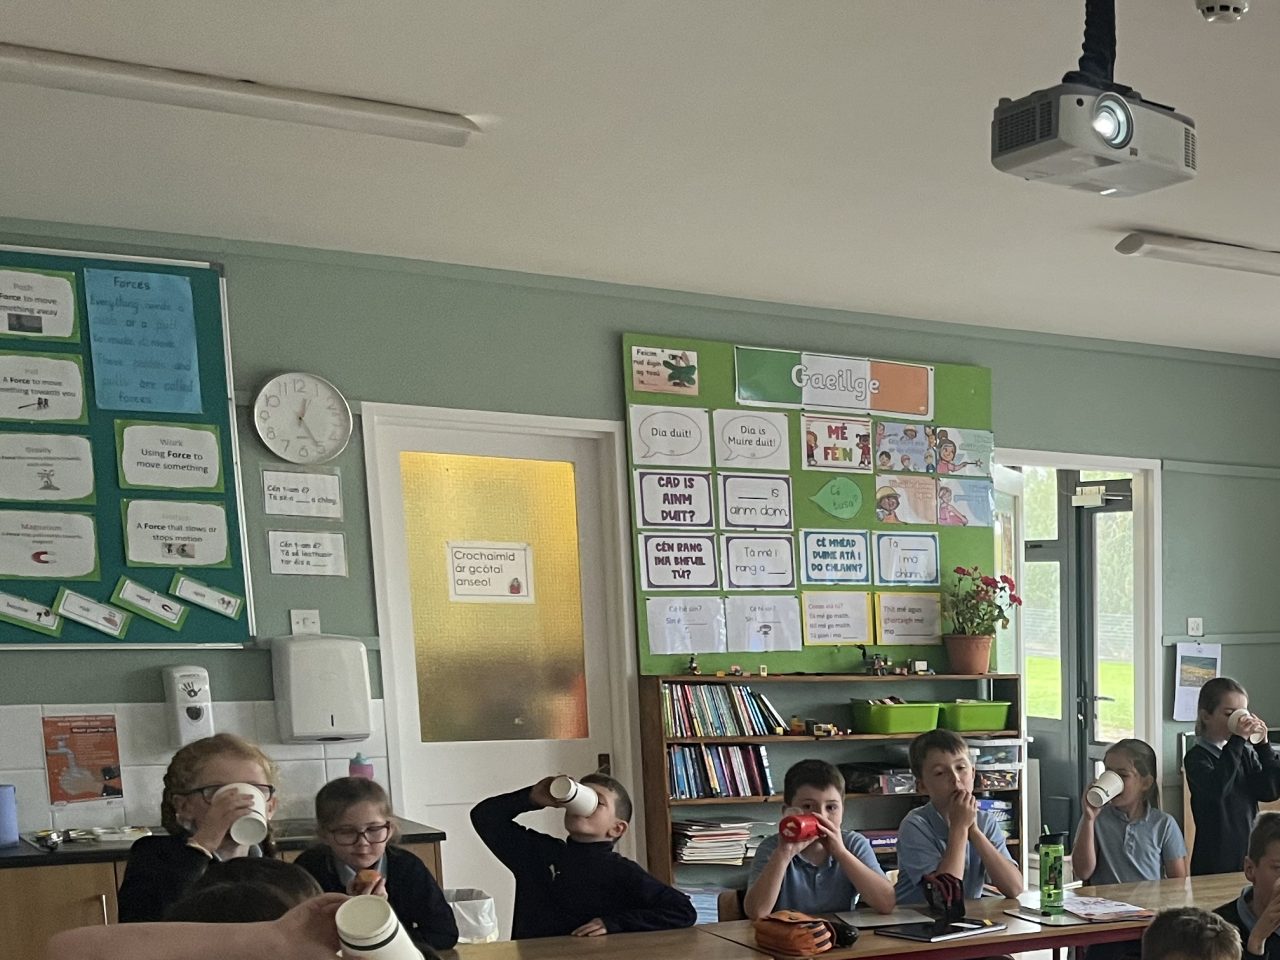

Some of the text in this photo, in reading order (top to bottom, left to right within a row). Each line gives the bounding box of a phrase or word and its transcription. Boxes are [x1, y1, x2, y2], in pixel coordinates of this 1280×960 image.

[113, 276, 151, 290] Forces
[90, 295, 138, 314] Everything
[636, 348, 657, 356] Feicim
[174, 360, 191, 371] and
[139, 377, 194, 392] are called
[293, 379, 306, 393] 12
[791, 363, 880, 402] Gaeilge
[265, 393, 281, 408] 10
[266, 426, 276, 440] 8
[651, 427, 692, 438] Dia duit!
[740, 425, 766, 435] Dia is
[827, 422, 848, 441] MÉ
[281, 439, 290, 453] 7
[728, 436, 776, 447] Muire duit!
[141, 448, 166, 459] Using
[167, 450, 192, 460] Force
[299, 445, 308, 458] 6
[823, 443, 853, 462] FÉIN
[136, 461, 209, 474] move something
[657, 476, 695, 489] CAD IS
[662, 493, 692, 505] AINM
[660, 510, 696, 523] DUIT?
[729, 506, 757, 515] ainm
[144, 523, 166, 531] Force
[167, 524, 183, 532] that
[152, 533, 174, 542] stops
[816, 537, 856, 547] CÉ MHÉAD
[888, 537, 898, 549] Tá
[656, 541, 702, 552] CÉN RANG
[744, 547, 772, 558] Tá mé
[454, 550, 516, 561] Crochaimid
[654, 556, 705, 566] INA BHFUIL
[812, 550, 855, 560] DUINE ATÁ
[903, 556, 918, 564] mo
[671, 568, 692, 580] TÚ?
[735, 564, 757, 576] rang
[811, 563, 863, 573] DO CHLANN?
[456, 578, 491, 587] anseo!
